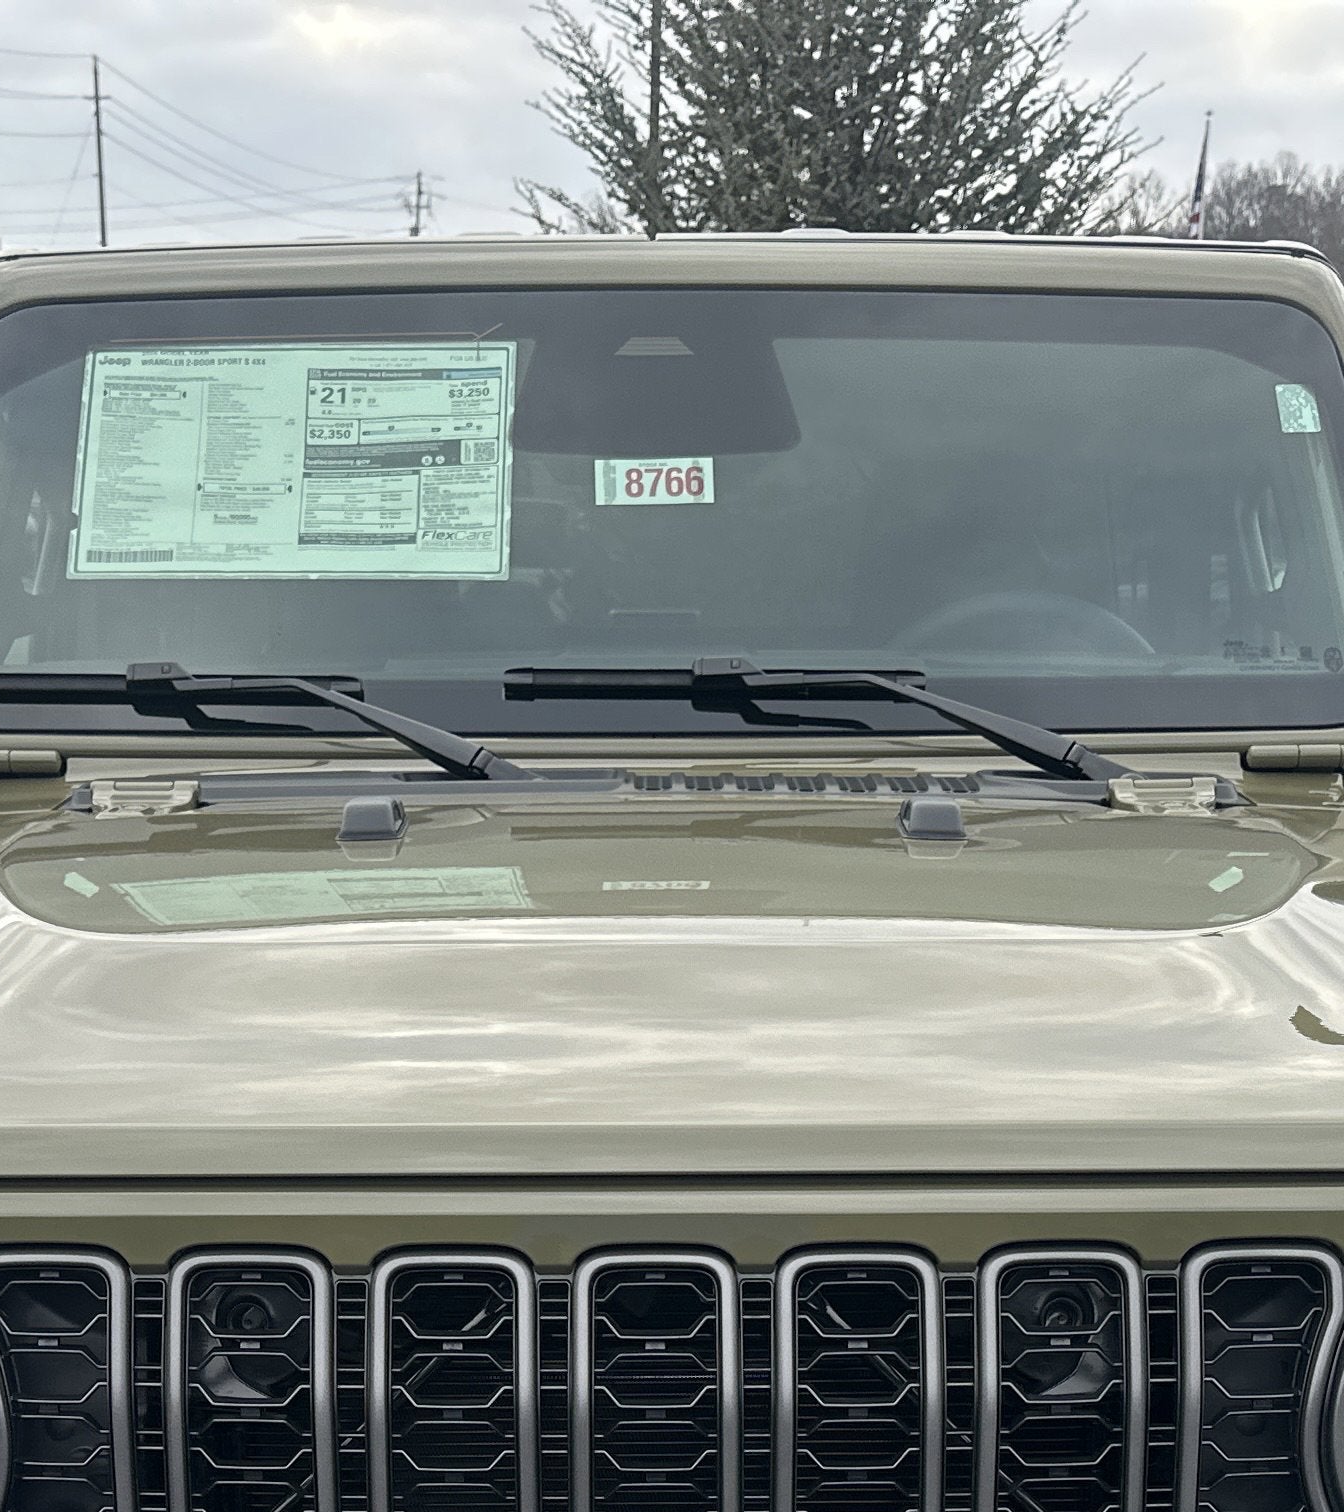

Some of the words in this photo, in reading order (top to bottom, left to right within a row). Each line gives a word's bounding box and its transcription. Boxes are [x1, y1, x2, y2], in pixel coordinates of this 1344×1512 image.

[97, 355, 132, 367] Jeep
[140, 358, 185, 367] WRANGLER
[186, 358, 216, 367] 2-DOOR
[217, 358, 243, 366] SPORT
[319, 386, 347, 405] 21
[448, 386, 491, 399] $3,250
[309, 429, 351, 440] $2,350
[625, 466, 705, 498] 8766
[421, 530, 493, 541] FlexCare
